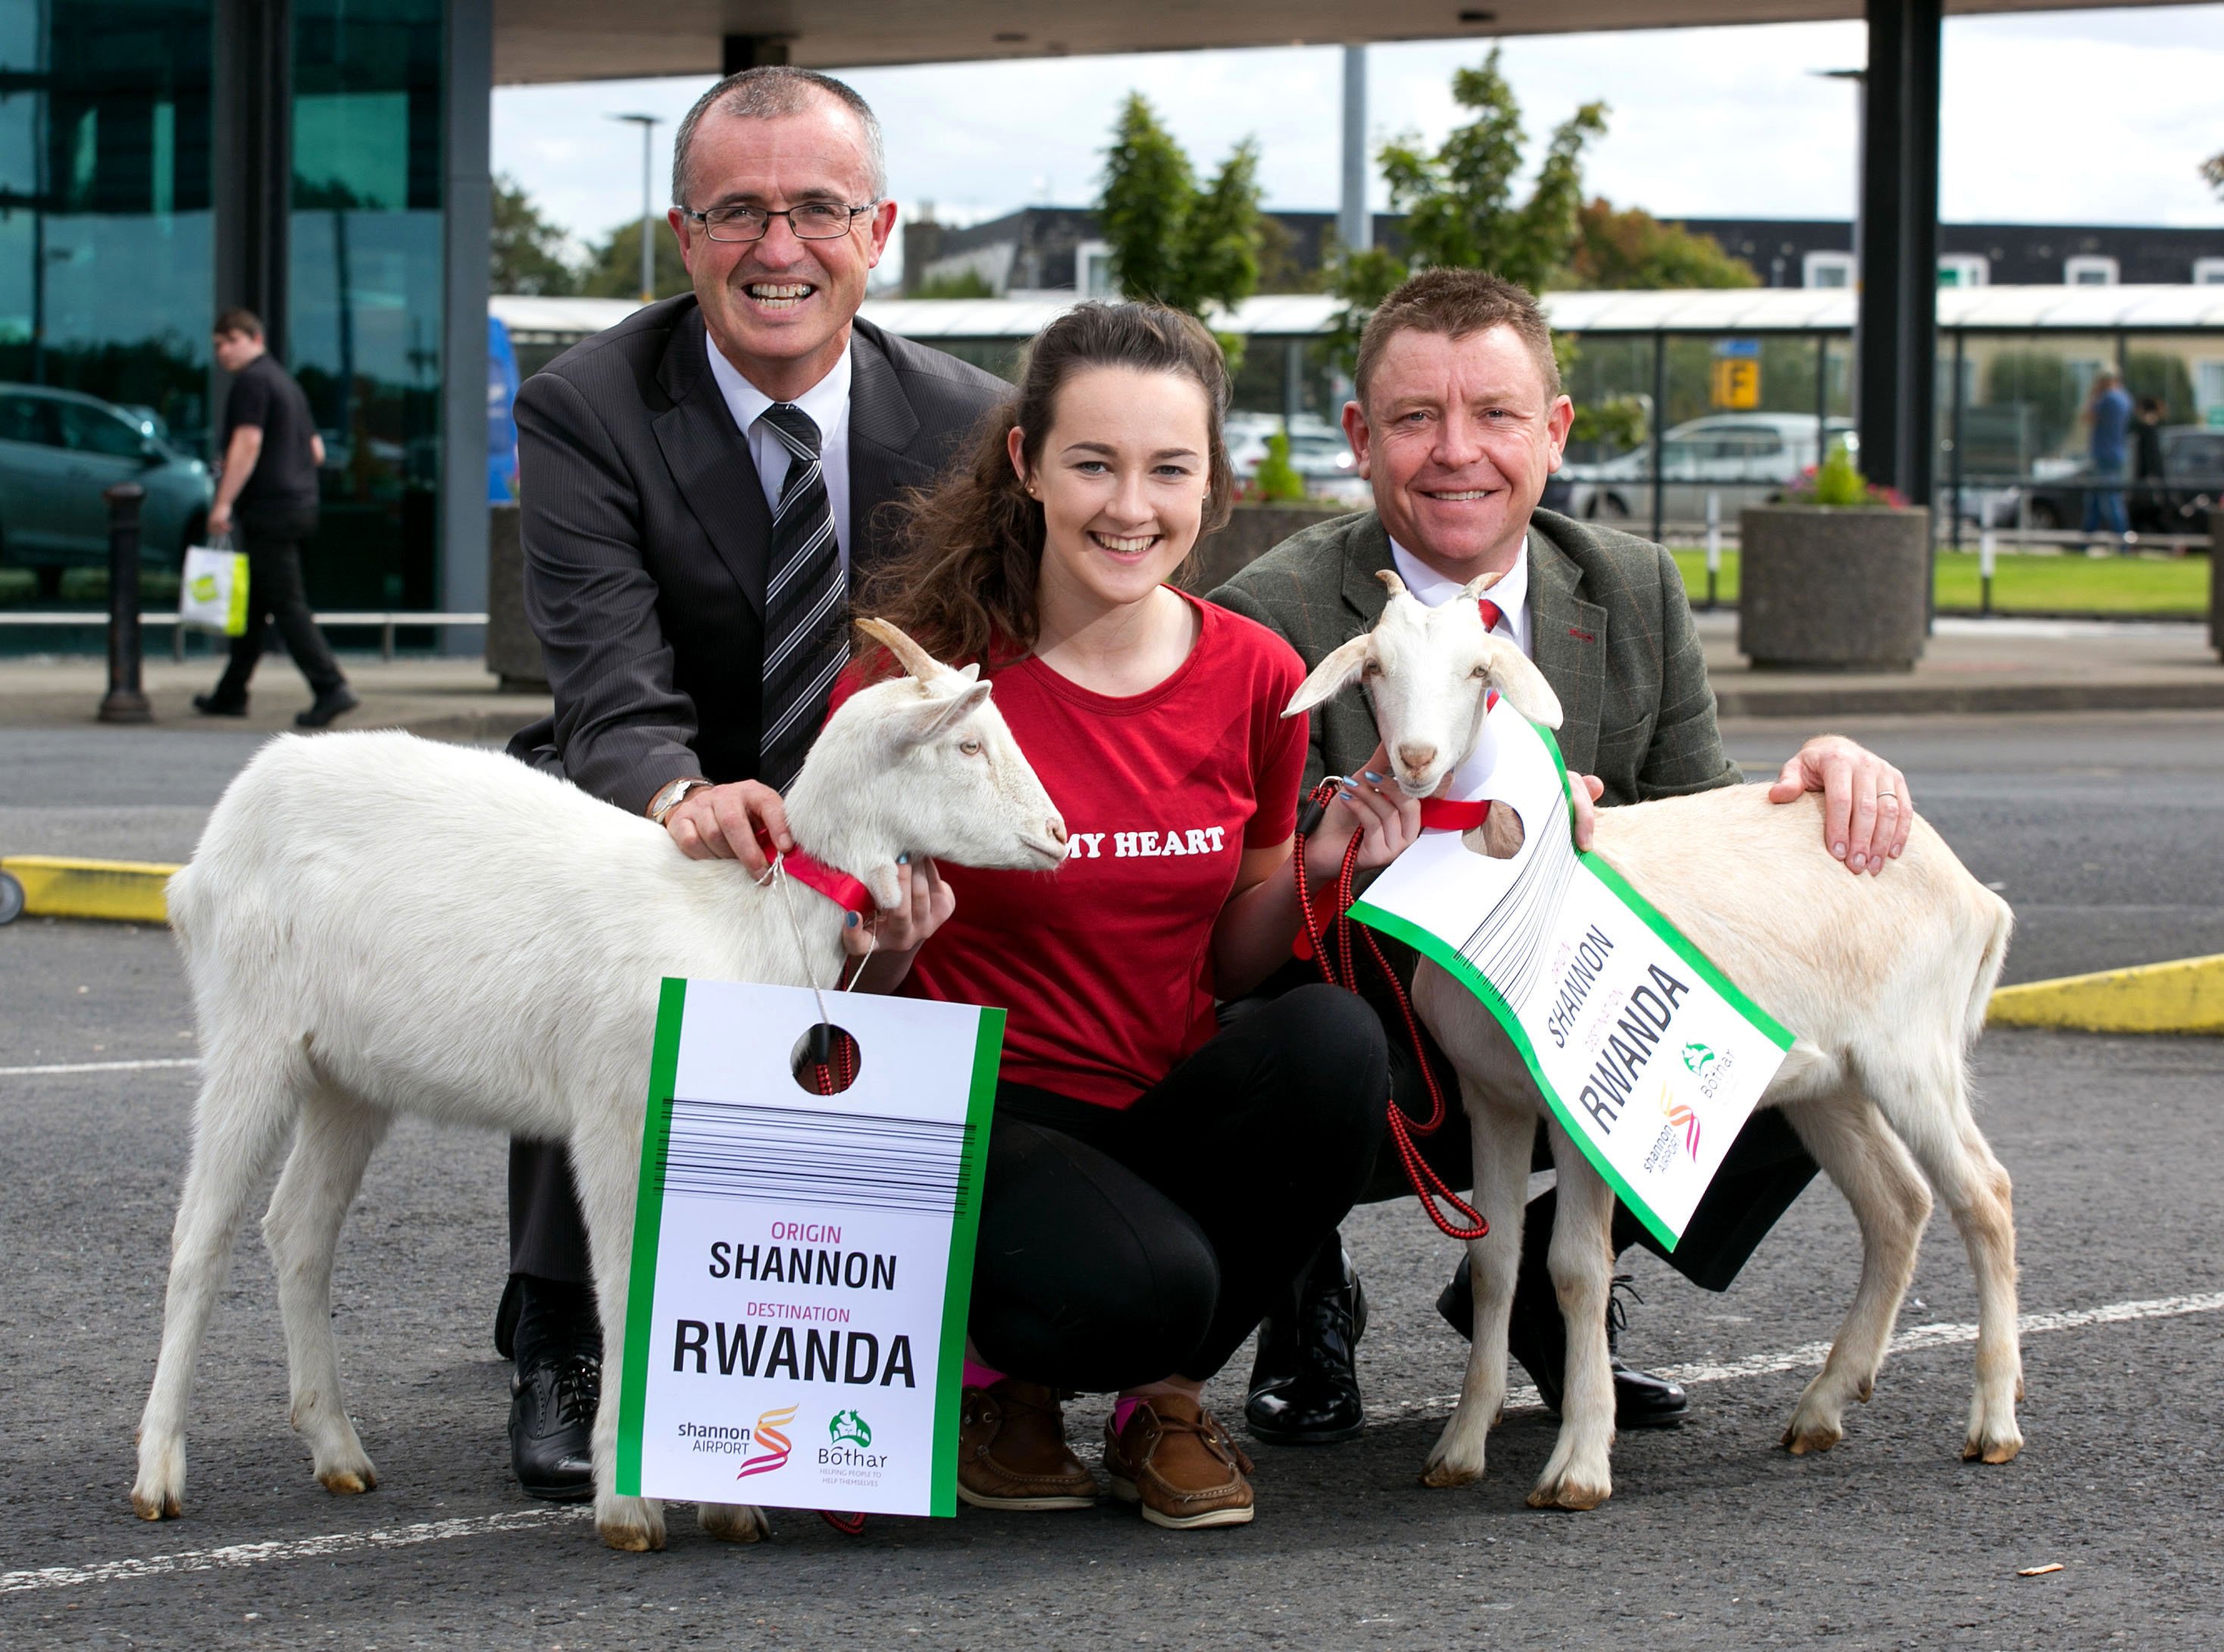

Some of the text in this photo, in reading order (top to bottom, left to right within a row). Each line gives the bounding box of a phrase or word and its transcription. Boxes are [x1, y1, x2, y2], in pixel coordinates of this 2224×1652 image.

[1113, 826, 1225, 858] HEART
[1548, 924, 1614, 1049] SHANNON
[1578, 963, 1691, 1135] RWANDA
[1644, 1125, 1673, 1174] shannon
[1658, 1133, 1681, 1175] AIRPORT
[771, 1222, 841, 1244] ORIGIN
[708, 1241, 897, 1291] SHANNON
[746, 1302, 850, 1323] DESTINATION
[673, 1319, 916, 1388] RWANDA
[678, 1422, 750, 1440] shannon
[693, 1440, 749, 1454] AIRPORT
[820, 1468, 847, 1476] HELPING
[849, 1469, 871, 1478] PEOPLE
[839, 1478, 878, 1487] THEMSELVES
